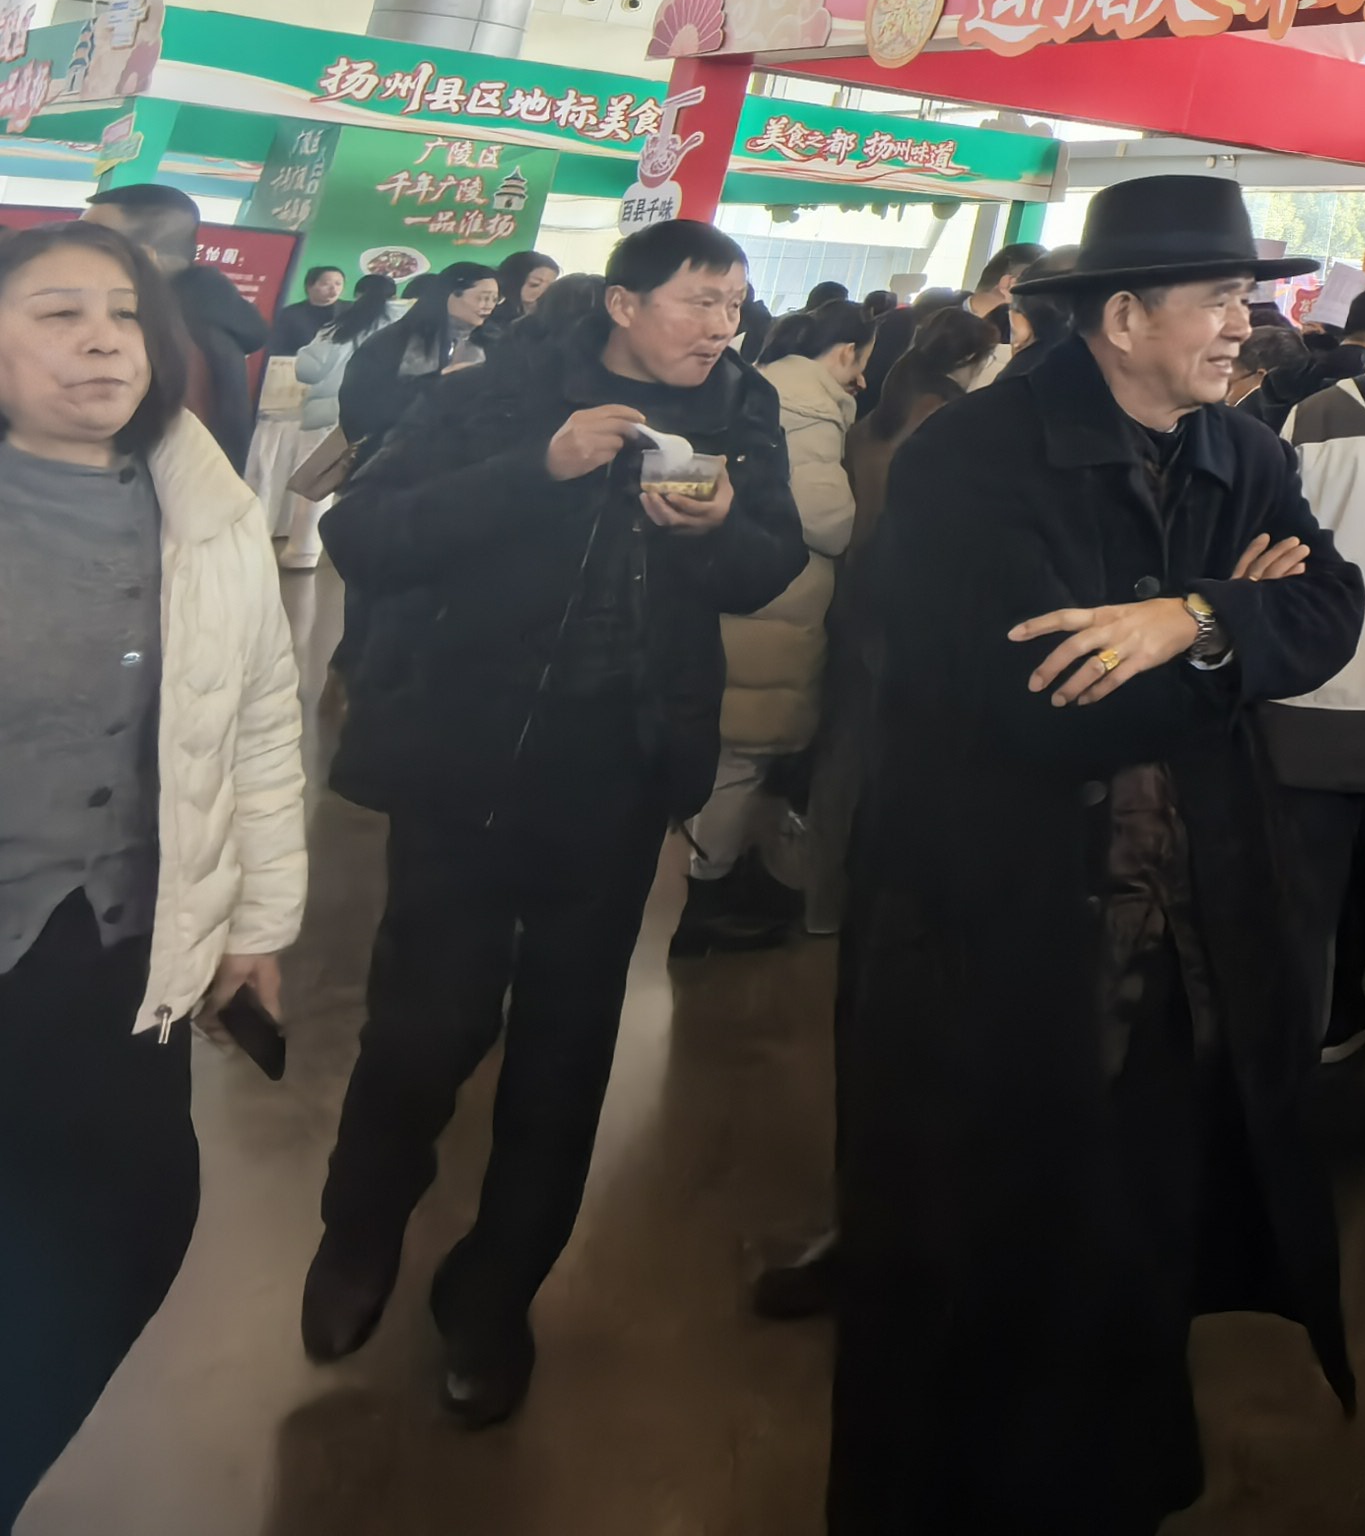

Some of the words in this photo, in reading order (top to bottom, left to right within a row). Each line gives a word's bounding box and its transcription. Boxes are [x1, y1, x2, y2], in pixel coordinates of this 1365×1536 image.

[311, 57, 665, 141] 扬州县区地标美食
[413, 136, 504, 169] 广陵区
[746, 116, 858, 163] 美食之都
[858, 130, 968, 176] 扬州味道
[376, 170, 490, 205] 千年广陵
[403, 209, 518, 246] 一品淮扬
[622, 197, 674, 222] 百县千味
